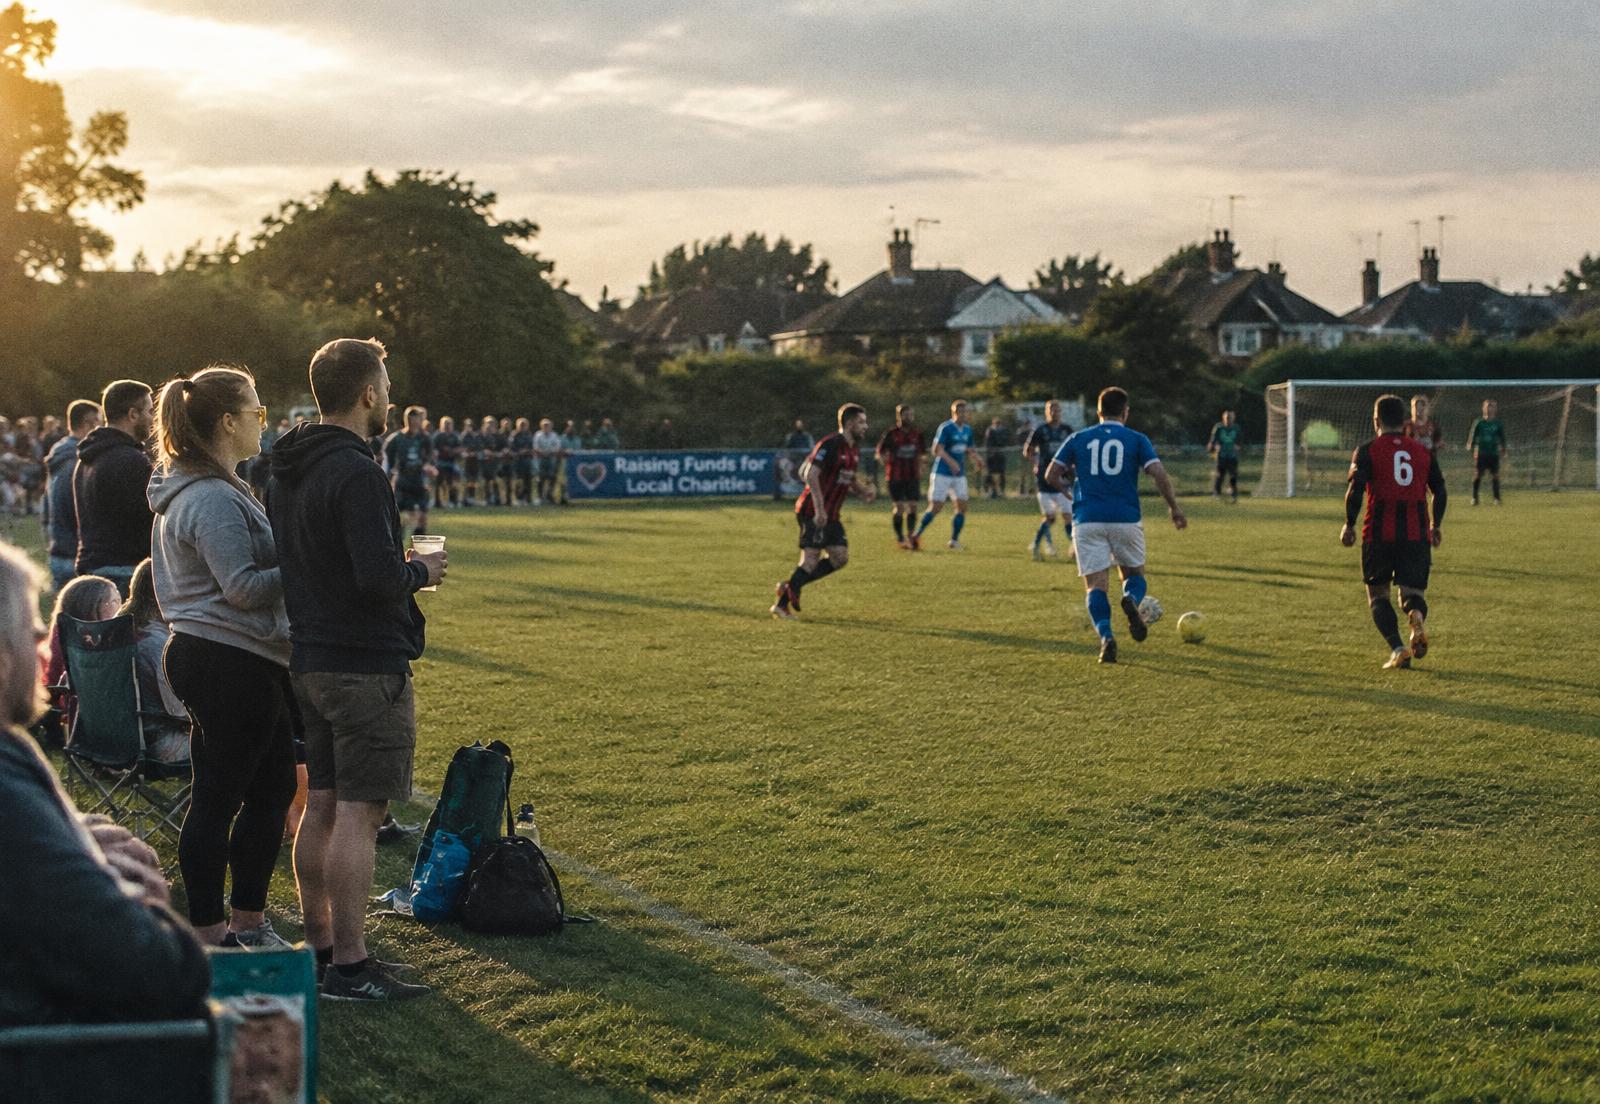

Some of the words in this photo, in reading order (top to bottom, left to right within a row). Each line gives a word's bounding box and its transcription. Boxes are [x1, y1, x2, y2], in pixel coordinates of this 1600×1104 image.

[615, 457, 680, 475] Raising
[684, 455, 737, 472] Funds
[740, 454, 767, 471] for
[1086, 438, 1125, 476] 10
[1393, 450, 1414, 487] 6
[626, 477, 674, 494] Local
[677, 476, 756, 493] Charities
